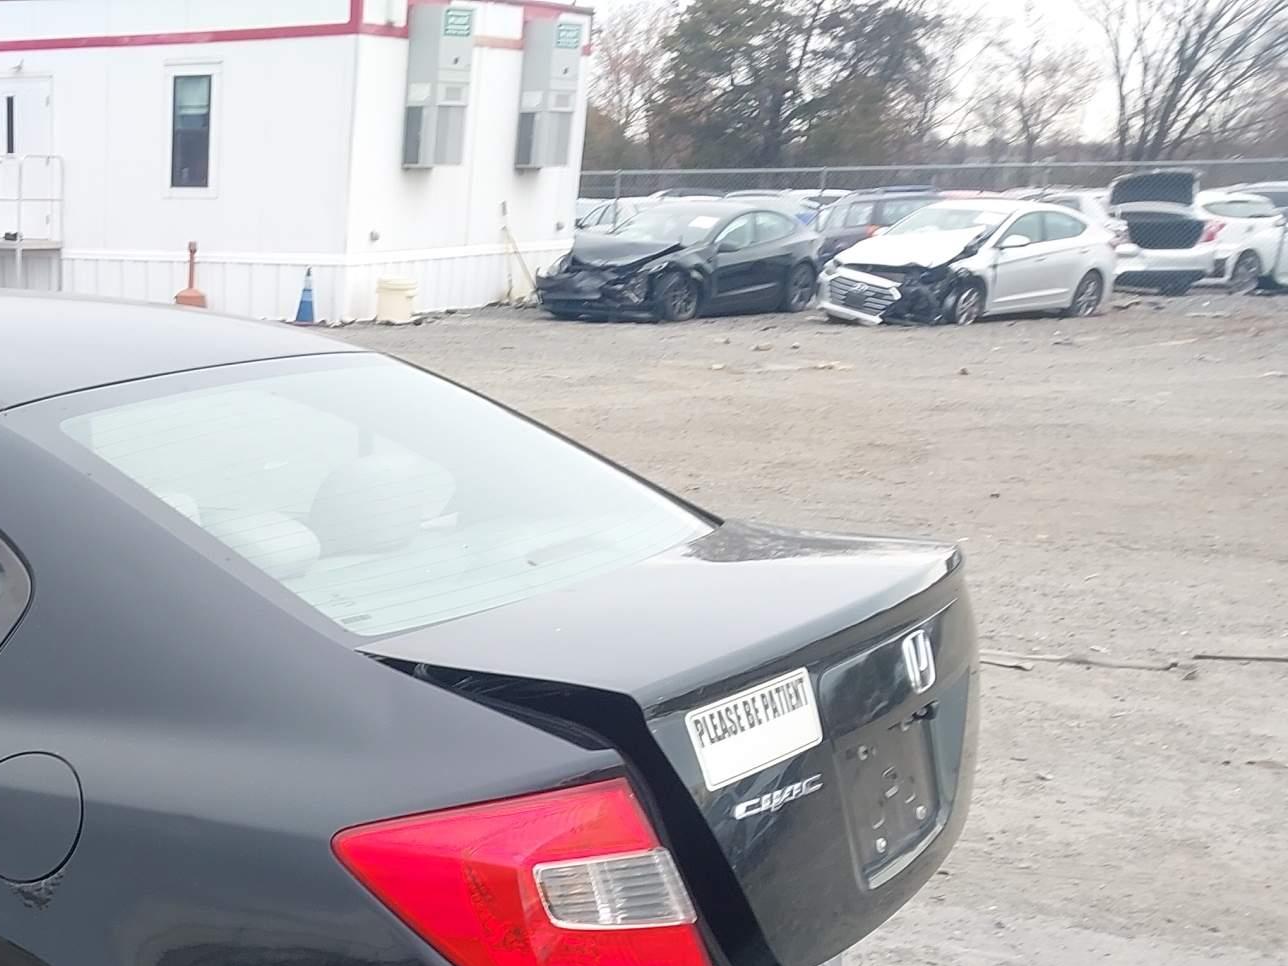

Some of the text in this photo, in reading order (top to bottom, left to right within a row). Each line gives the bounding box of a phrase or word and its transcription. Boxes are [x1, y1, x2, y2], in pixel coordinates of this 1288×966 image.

[694, 677, 808, 747] PLEASE BE PATIENT
